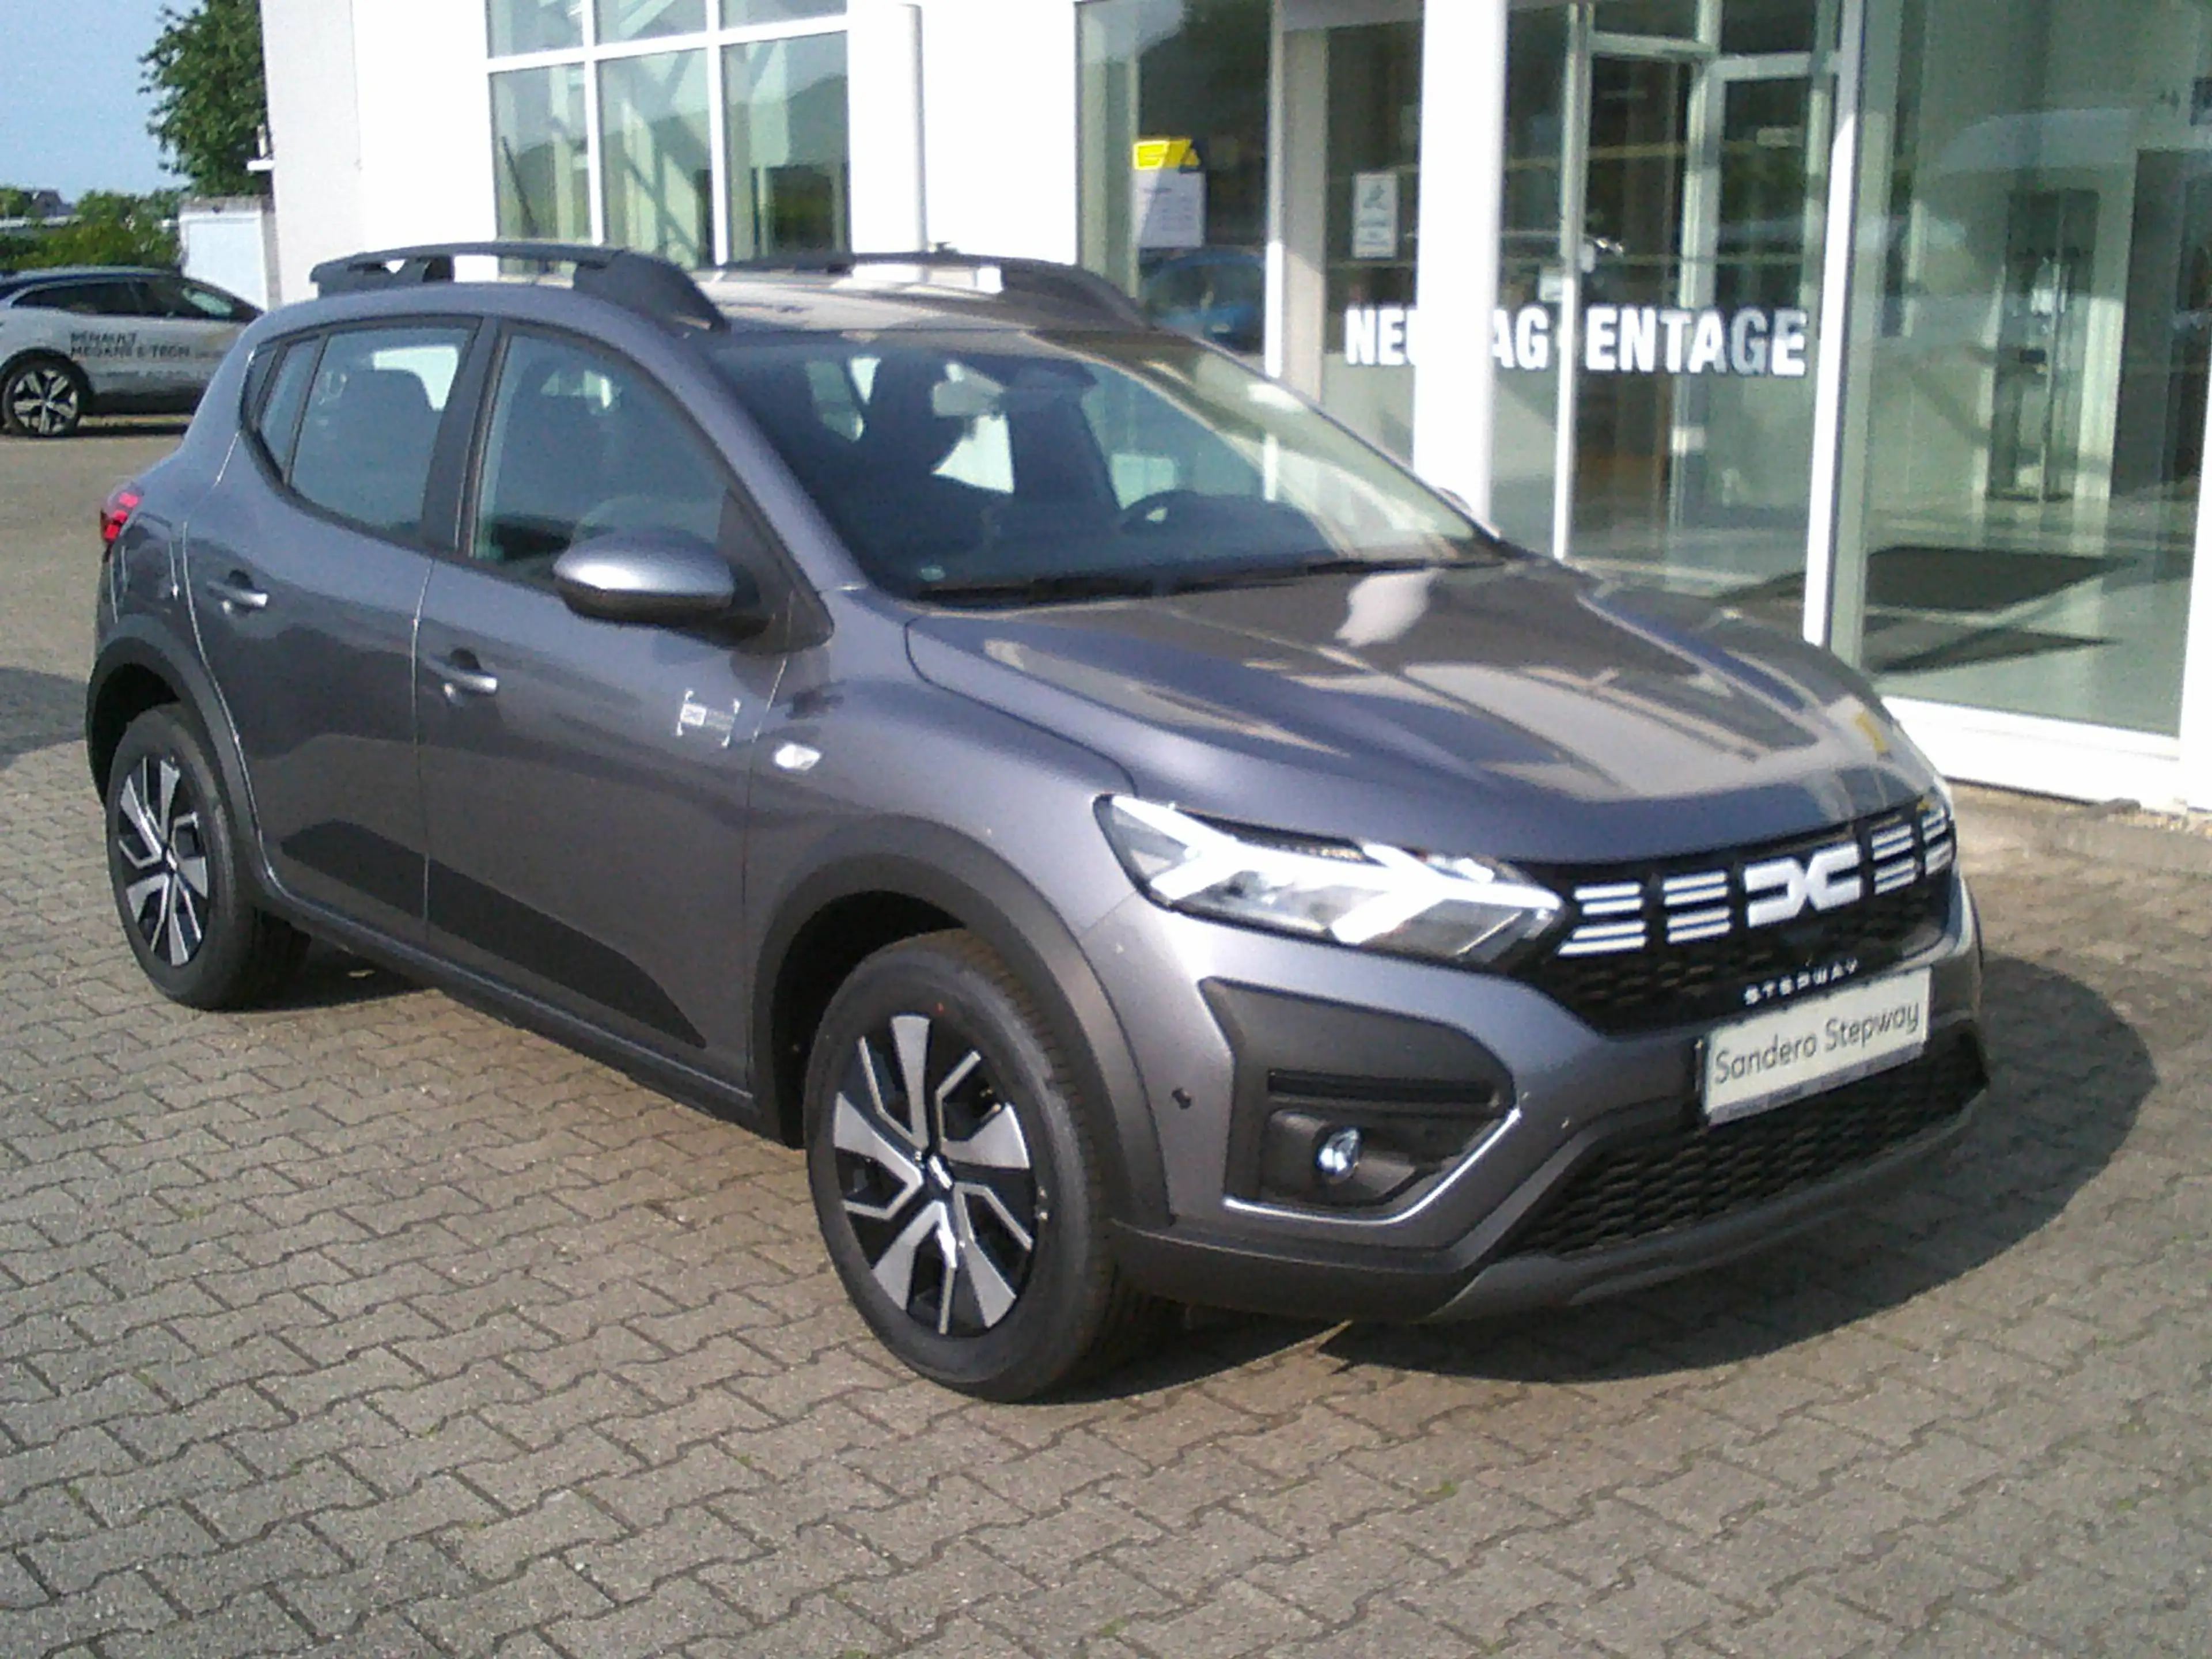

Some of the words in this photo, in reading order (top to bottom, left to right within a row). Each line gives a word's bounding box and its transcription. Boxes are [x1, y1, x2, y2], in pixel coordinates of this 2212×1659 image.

[1743, 956, 1859, 1006] STEPWAY
[1714, 1033, 1818, 1085] Sandero
[1825, 1002, 1920, 1052] Stepway
